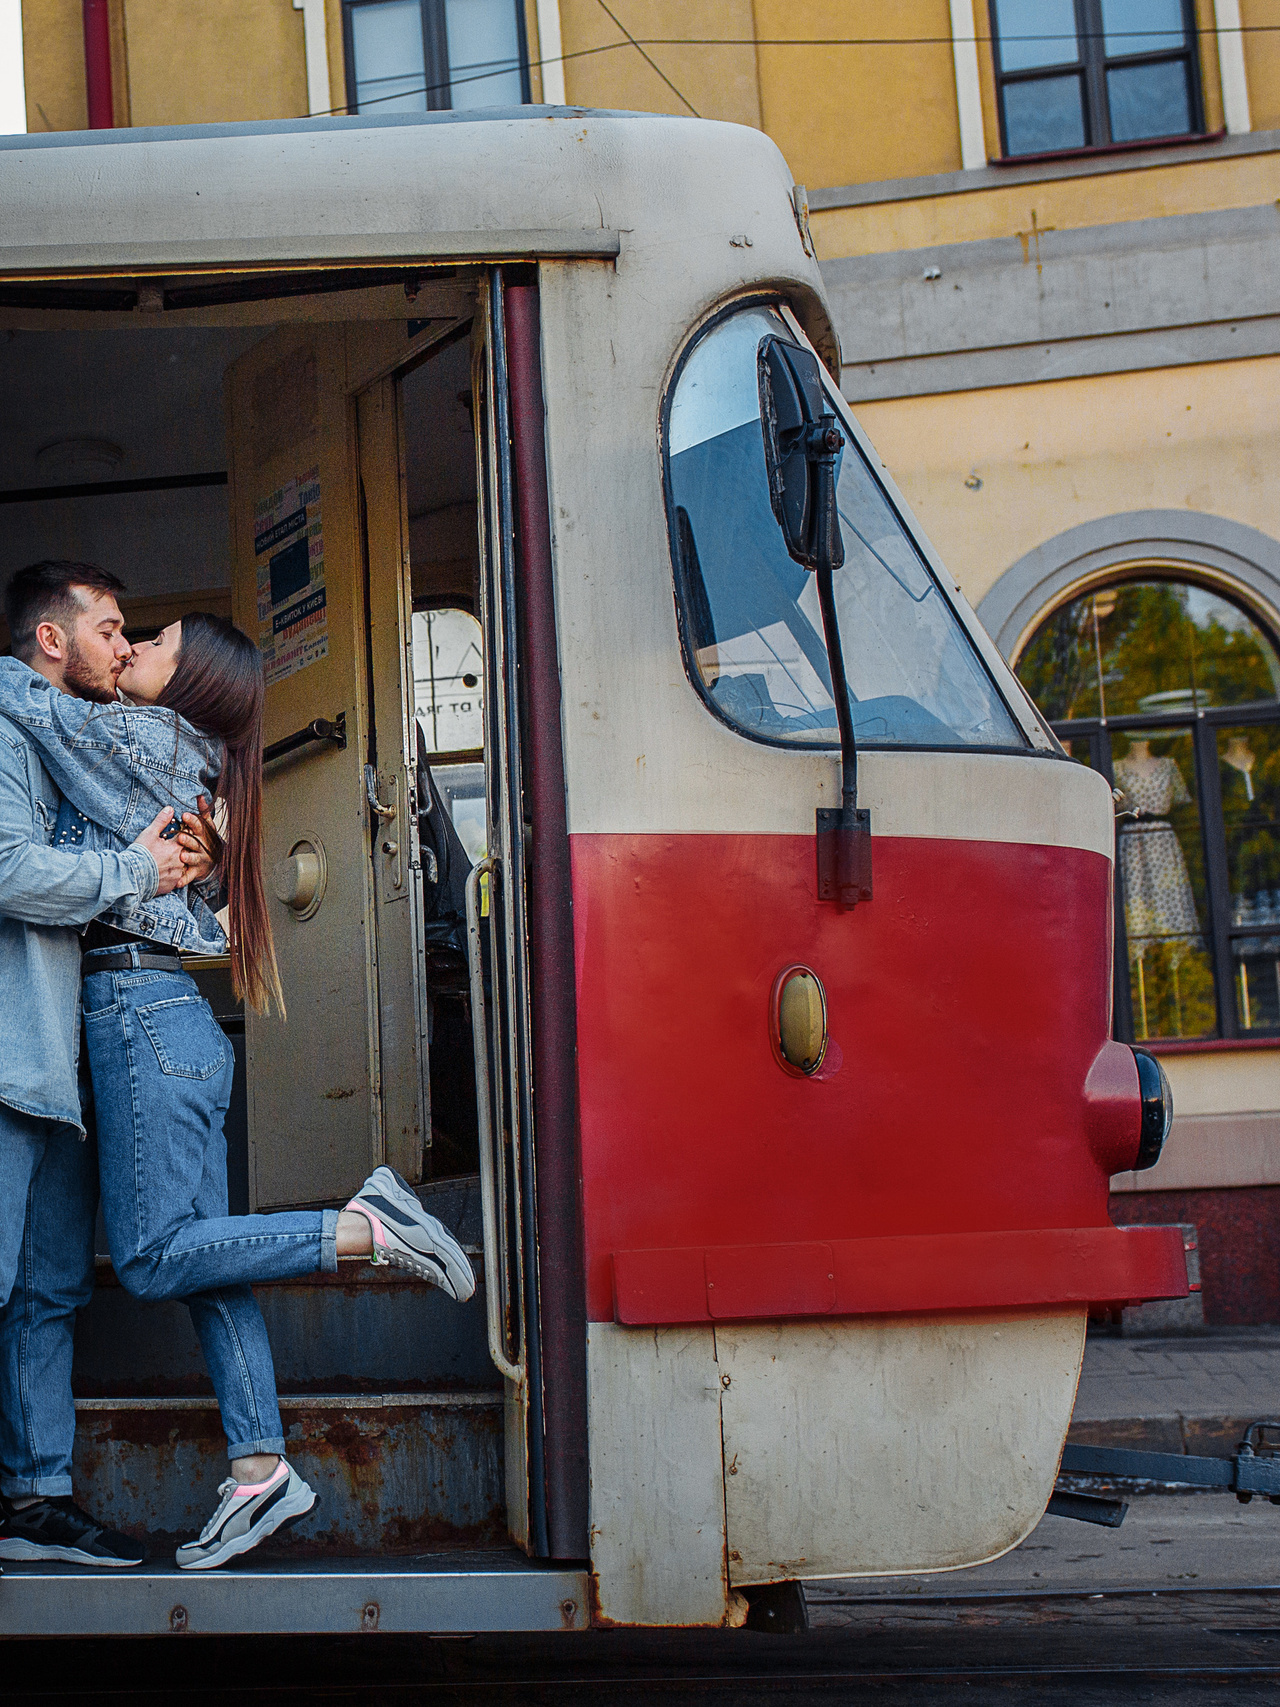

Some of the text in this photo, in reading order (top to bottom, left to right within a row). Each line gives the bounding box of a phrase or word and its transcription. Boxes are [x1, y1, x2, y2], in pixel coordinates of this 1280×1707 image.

[256, 530, 275, 550] НОВИЙ
[275, 522, 288, 539] ЕТАП
[288, 513, 306, 530] МІСТА
[275, 608, 302, 629] Е-КВИТОК
